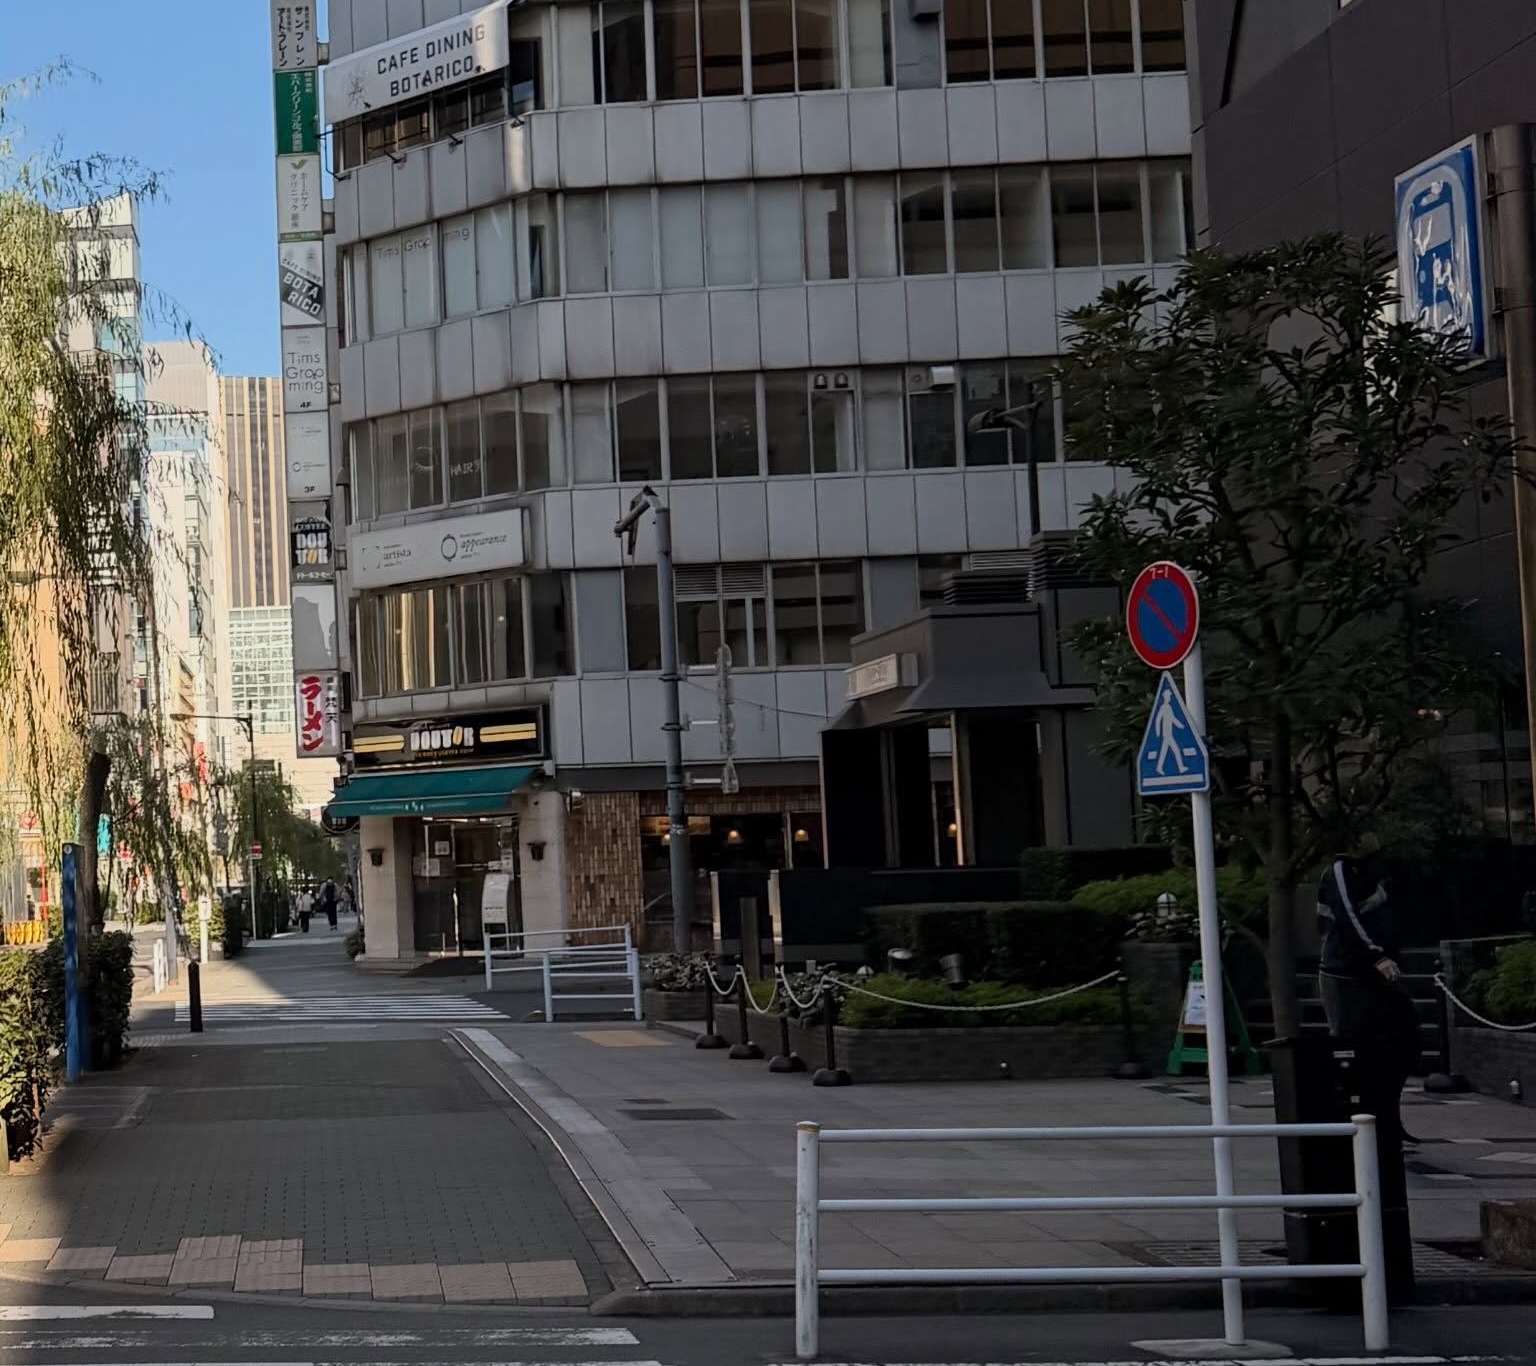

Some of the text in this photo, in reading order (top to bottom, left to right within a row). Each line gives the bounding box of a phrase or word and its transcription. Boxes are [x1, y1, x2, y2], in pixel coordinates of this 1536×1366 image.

[377, 24, 485, 75] CAFE DINING
[390, 55, 474, 97] BOTARICO
[283, 271, 319, 299] BOTA
[287, 290, 321, 316] RICO
[287, 352, 321, 364] Tims
[288, 380, 324, 395] ming
[296, 532, 327, 549] DOU
[300, 675, 323, 752] ラーメン
[410, 725, 474, 751] DOUTOR
